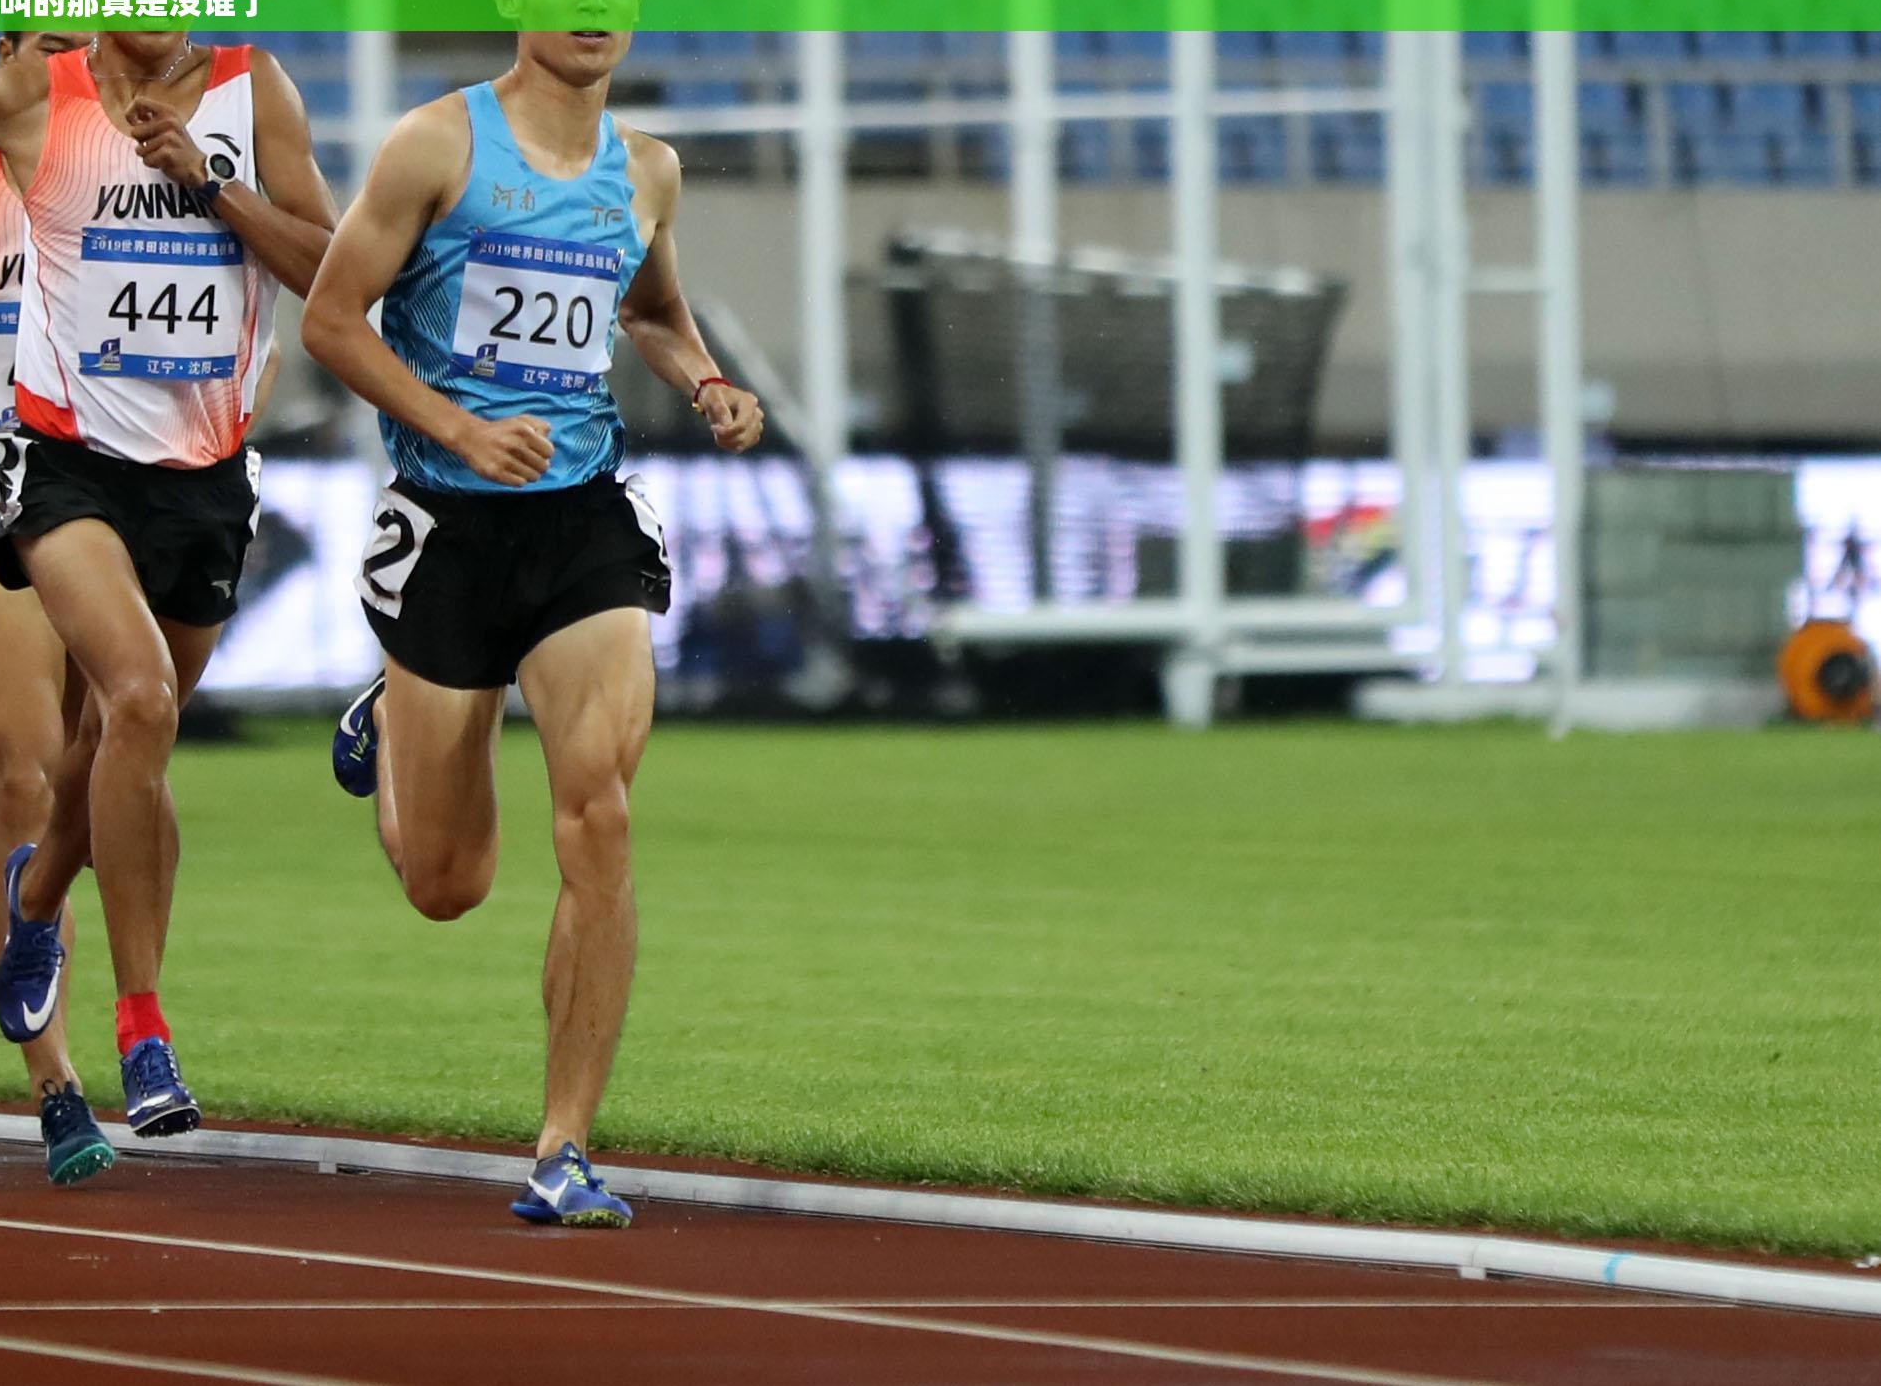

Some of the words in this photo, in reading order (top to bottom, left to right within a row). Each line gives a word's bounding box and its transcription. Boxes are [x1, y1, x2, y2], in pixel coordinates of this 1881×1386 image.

[107, 280, 219, 335] 444
[488, 285, 594, 349] 220
[365, 510, 417, 601] 2
